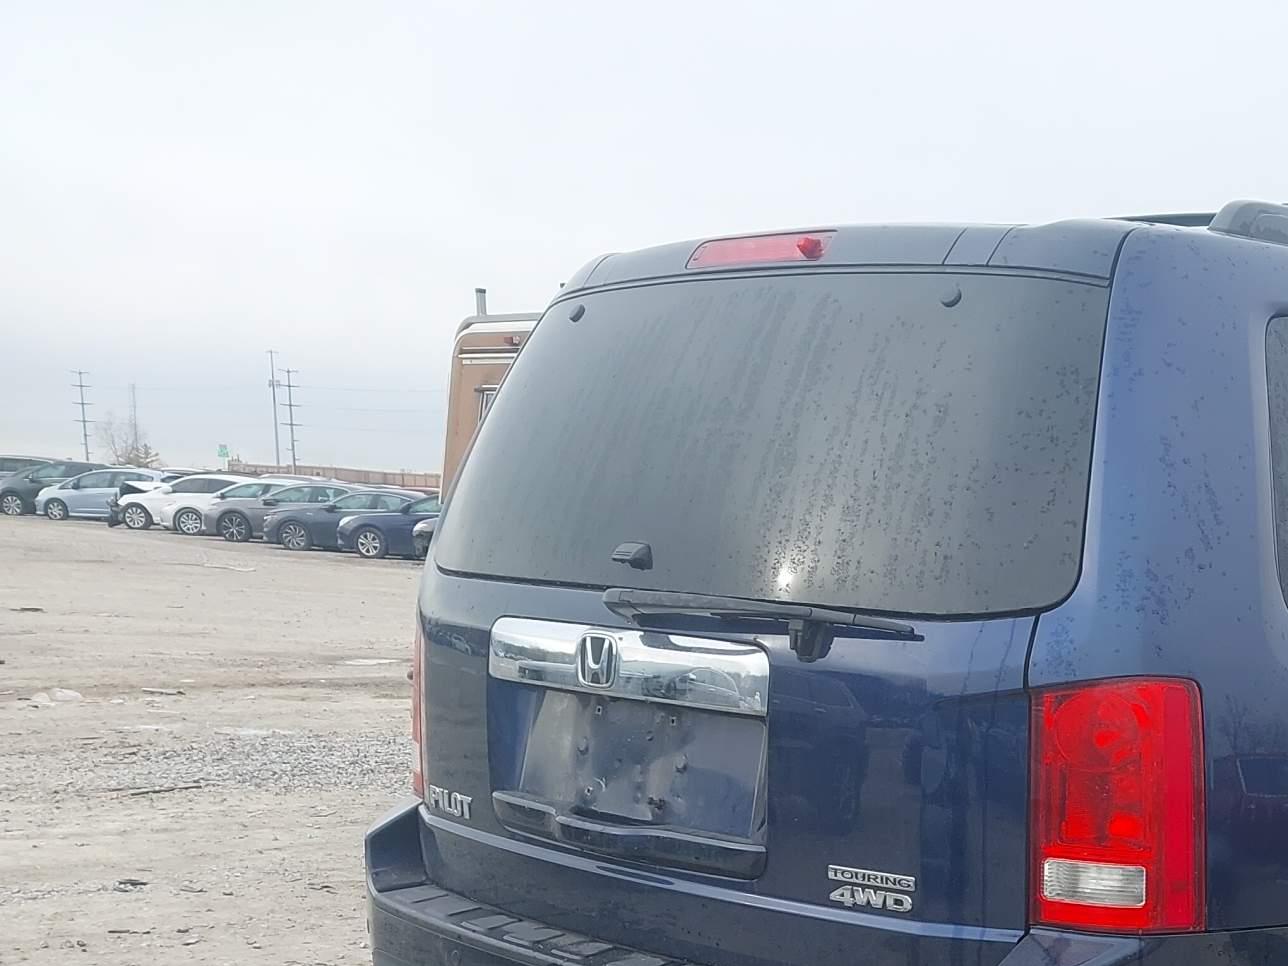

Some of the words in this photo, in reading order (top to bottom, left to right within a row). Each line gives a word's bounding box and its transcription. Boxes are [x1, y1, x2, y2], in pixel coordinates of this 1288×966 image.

[429, 784, 473, 820] PILOT
[831, 868, 913, 889] TOURING
[829, 885, 913, 912] 4WD
